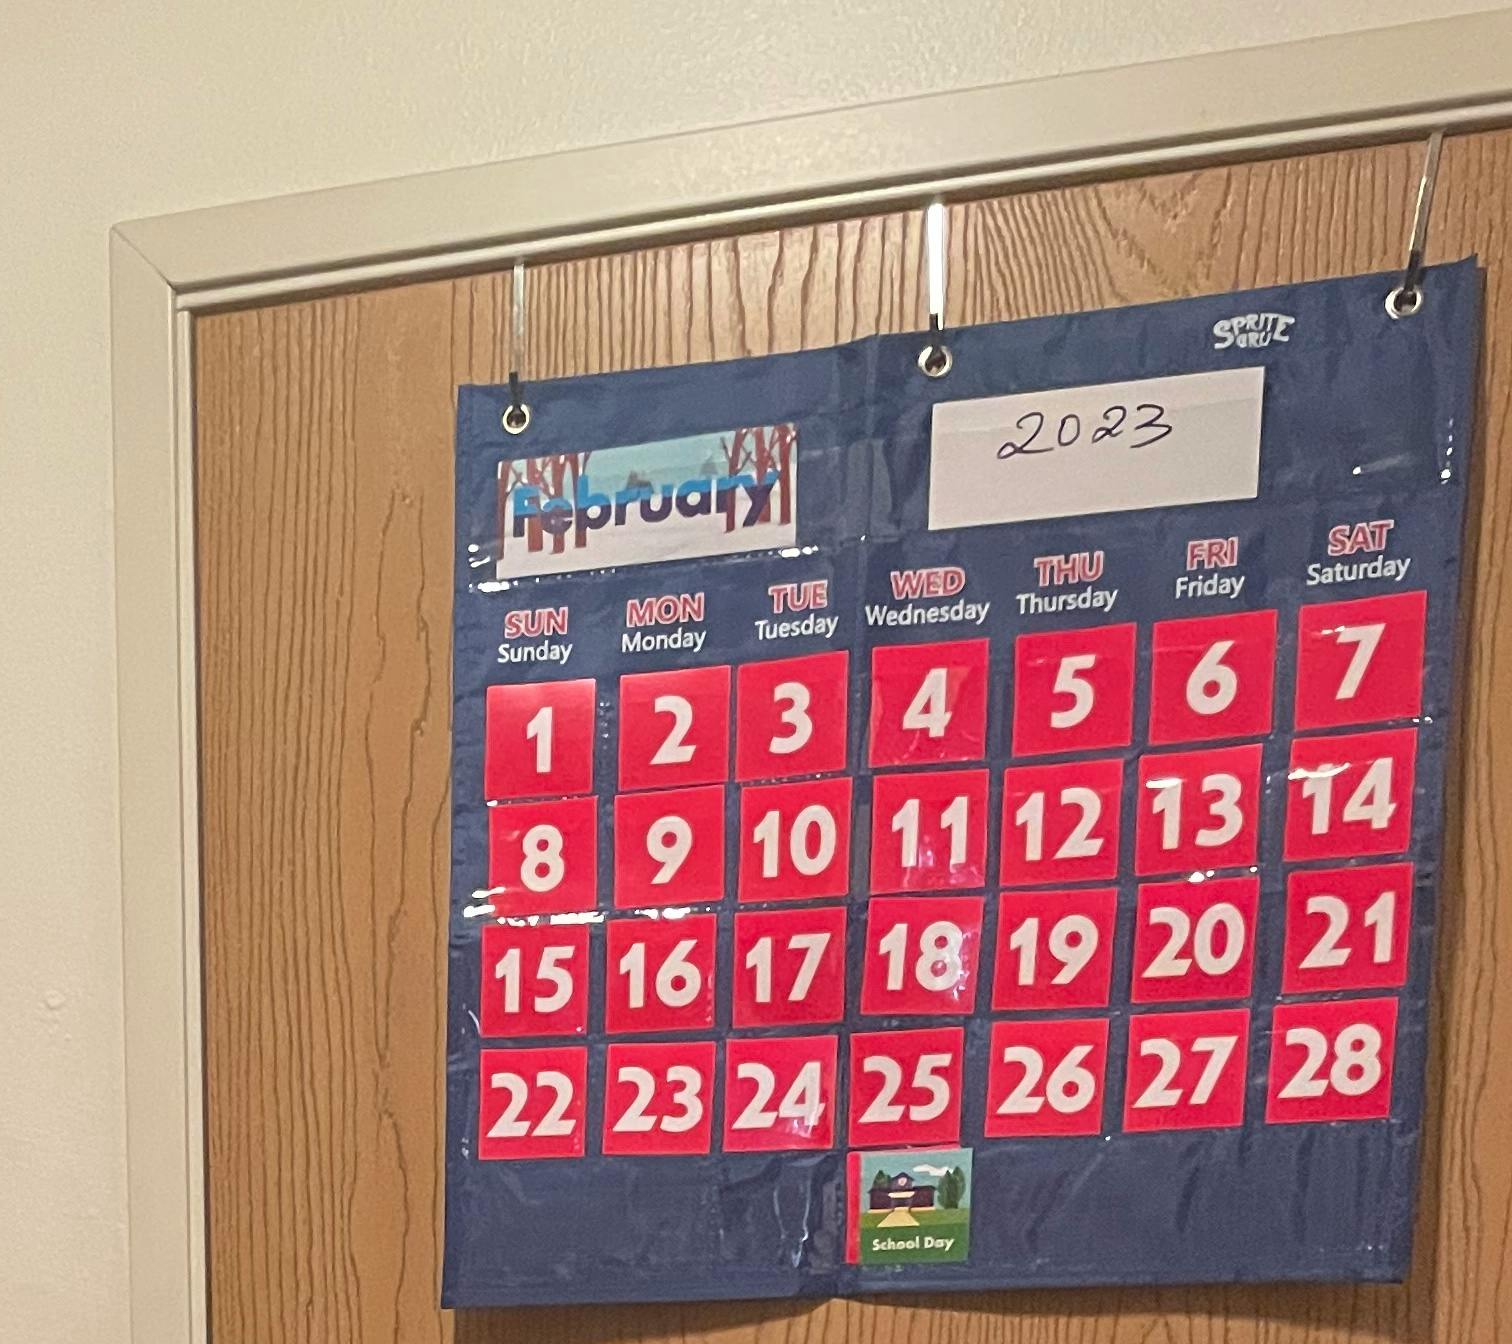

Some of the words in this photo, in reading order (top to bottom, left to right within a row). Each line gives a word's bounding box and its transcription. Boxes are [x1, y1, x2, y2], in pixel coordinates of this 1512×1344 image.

[1213, 312, 1296, 350] SPRITE
[996, 403, 1174, 461] 2023
[512, 466, 782, 539] February
[497, 641, 573, 664] Sunday
[621, 628, 706, 653] Monday
[754, 613, 839, 641] Tuesday
[864, 597, 991, 628] Wednesday
[1015, 587, 1118, 616] Thursday
[1175, 573, 1245, 600] Friday
[1306, 555, 1411, 587] Saturday
[504, 606, 568, 639] SUN
[626, 592, 705, 628] MON
[769, 579, 828, 614] TUE
[890, 566, 966, 600] WED
[1034, 551, 1104, 587] THU
[1186, 536, 1239, 570] FRI
[1327, 519, 1395, 556] SAT
[525, 706, 554, 774] 1
[648, 694, 697, 766] 2
[767, 681, 814, 756] 3
[902, 667, 953, 738] 4
[1050, 653, 1097, 729] 5
[1185, 640, 1238, 716] 6
[1334, 621, 1387, 701] 7
[519, 823, 565, 893] 8
[645, 814, 694, 885] 9
[752, 804, 837, 879] 10
[890, 797, 970, 872] 11
[1014, 786, 1105, 864] 12
[1150, 772, 1245, 852] 13
[1301, 755, 1398, 837] 14
[493, 944, 577, 1014] 15
[618, 938, 703, 1010] 16
[744, 932, 832, 1004] 17
[877, 919, 966, 992] 18
[1008, 913, 1100, 987] 19
[1140, 901, 1247, 979] 20
[1298, 889, 1397, 970] 21
[486, 1070, 578, 1138] 22
[611, 1064, 705, 1134] 23
[730, 1059, 827, 1131] 24
[857, 1052, 953, 1124] 25
[995, 1044, 1097, 1116] 26
[1131, 1034, 1240, 1109] 27
[1276, 1022, 1384, 1100] 28
[872, 1235, 921, 1251] School
[923, 1236, 955, 1252] Day
